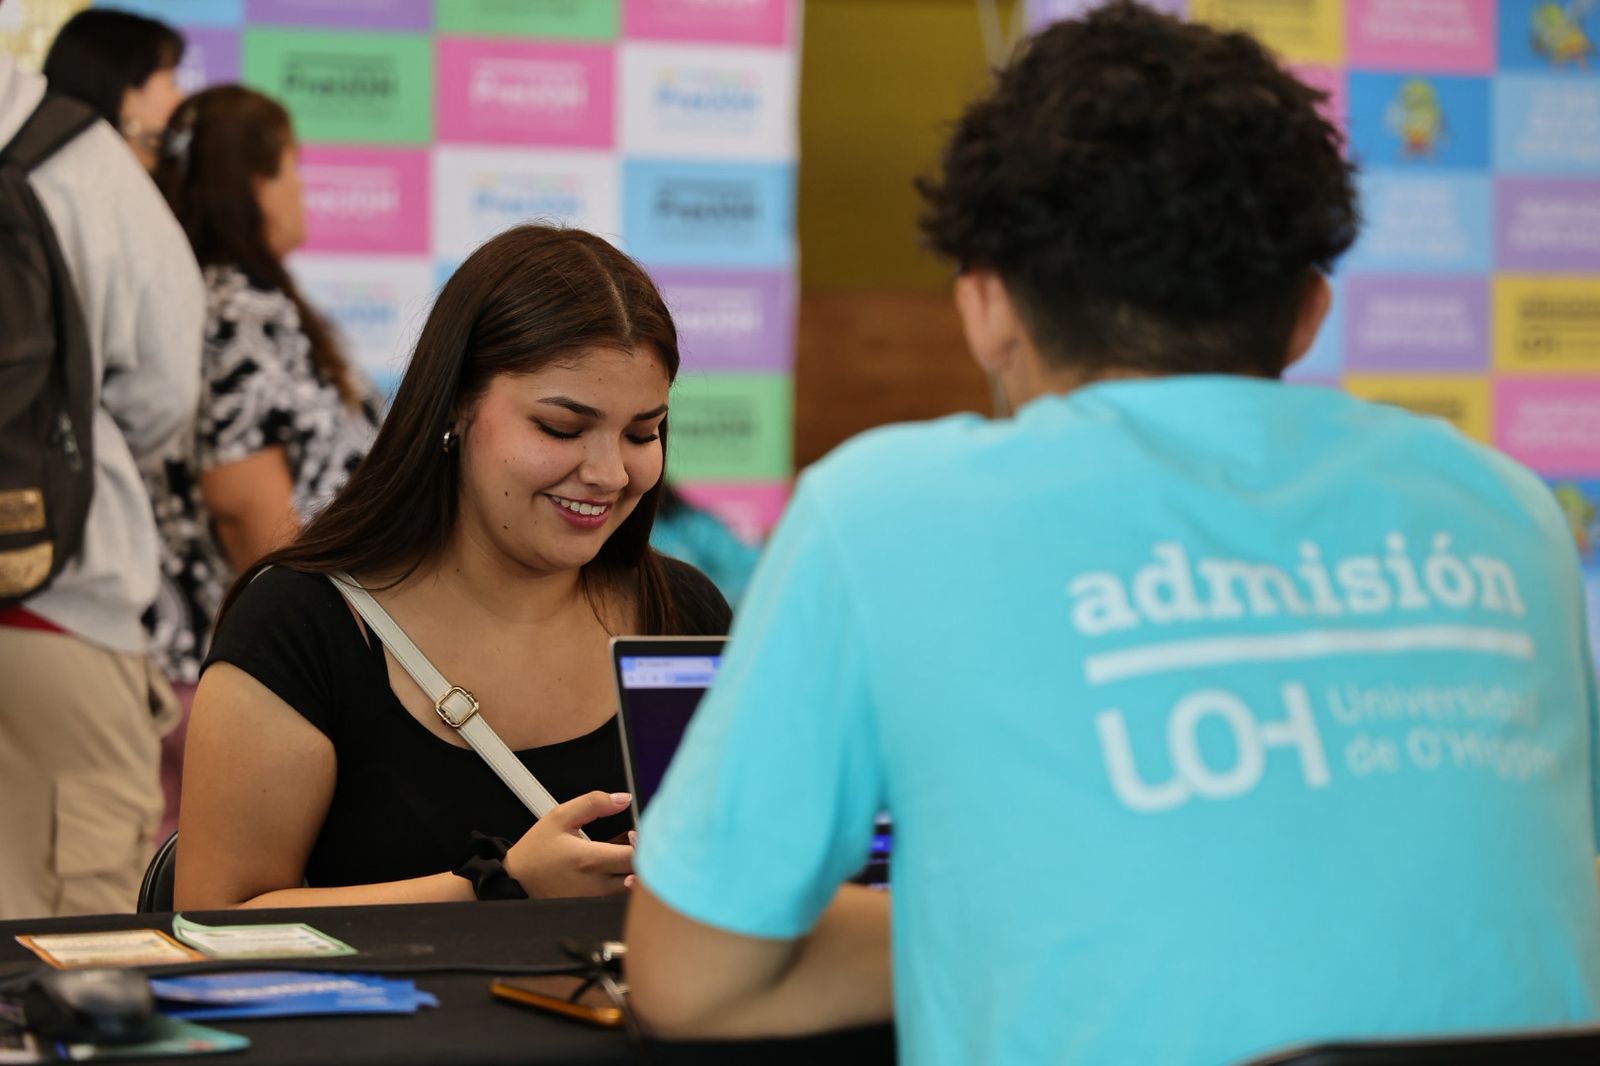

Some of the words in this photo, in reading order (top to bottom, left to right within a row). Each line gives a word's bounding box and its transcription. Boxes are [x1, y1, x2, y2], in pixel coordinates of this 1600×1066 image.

[1068, 532, 1526, 635] admisión
[1096, 681, 1331, 813] UOH
[1346, 735, 1400, 777] de
[1406, 727, 1558, 783] O'Higg
